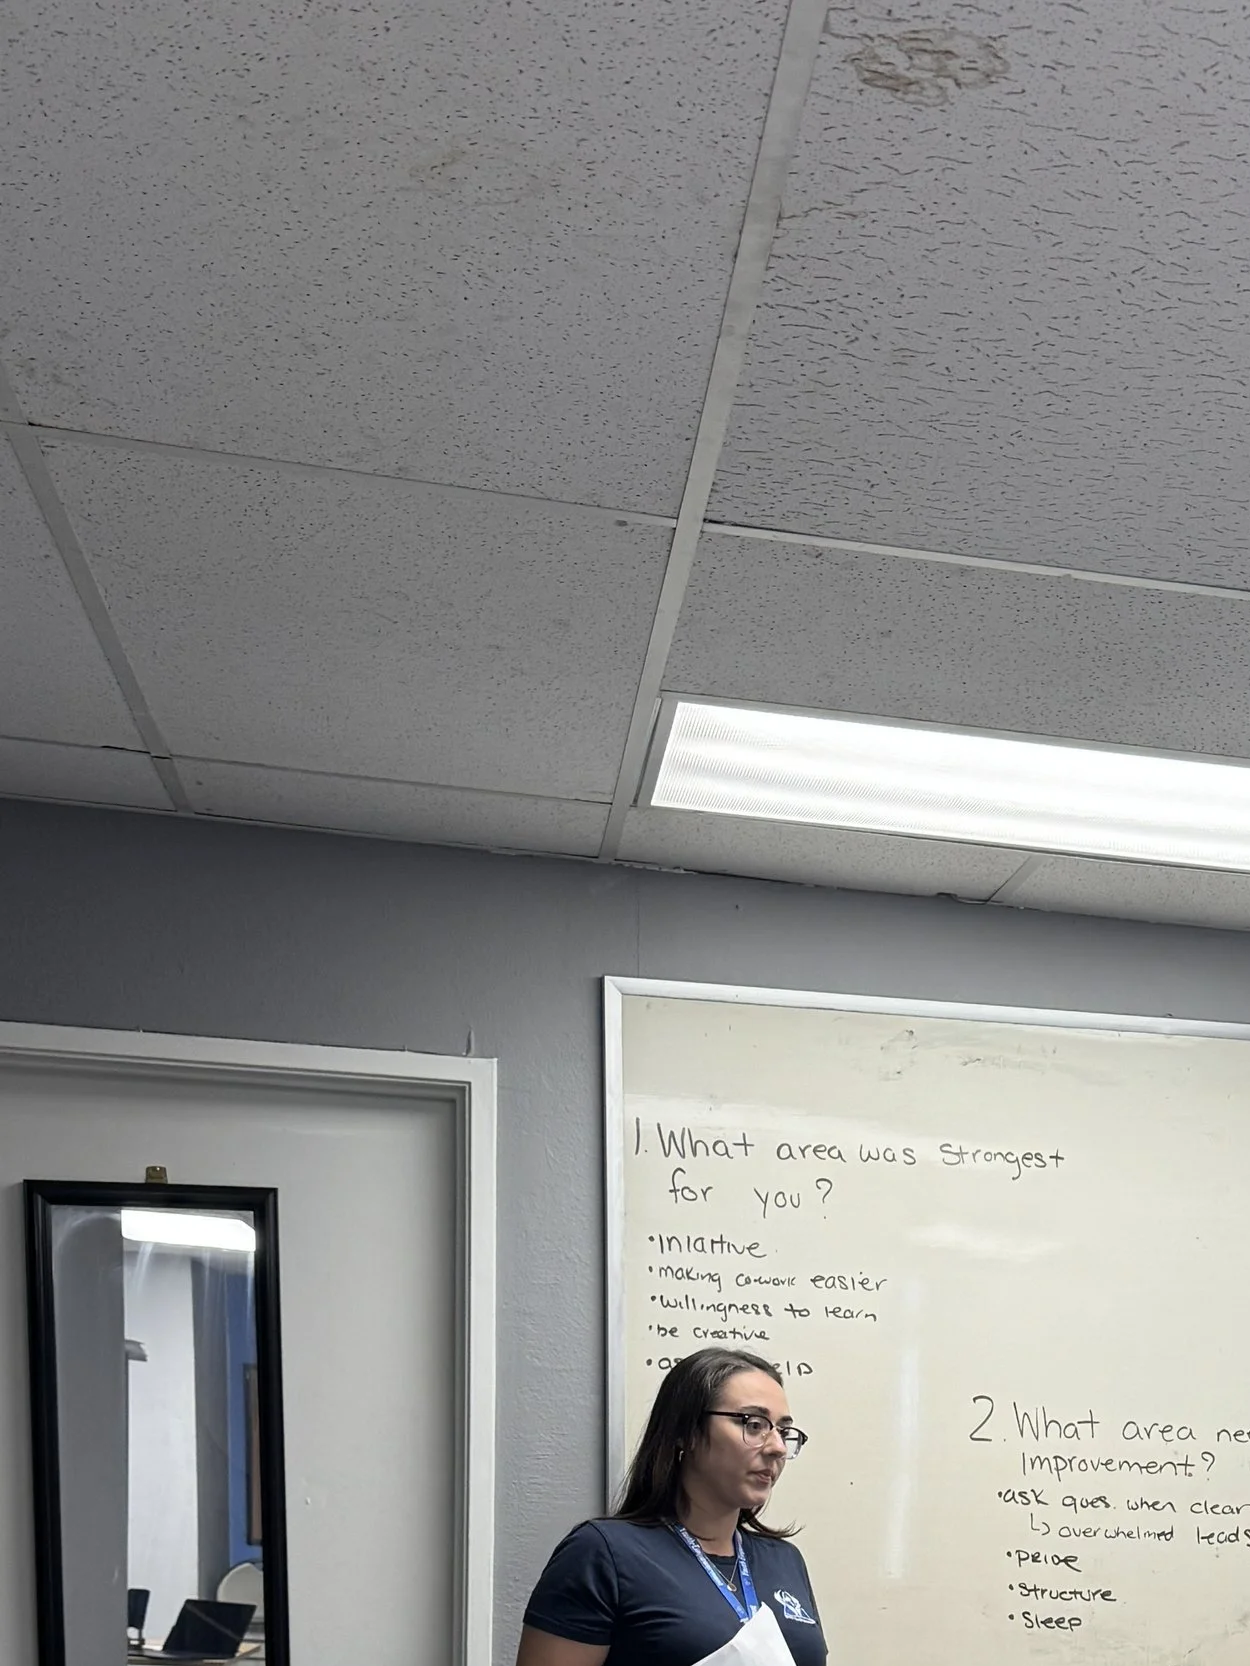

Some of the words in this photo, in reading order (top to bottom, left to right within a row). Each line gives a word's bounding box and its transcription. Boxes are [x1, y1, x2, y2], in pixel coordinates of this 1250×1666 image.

[657, 1123, 754, 1160] What
[777, 1144, 846, 1162] area
[859, 1146, 916, 1165] was
[669, 1168, 713, 1203] for
[659, 1267, 722, 1289] making
[810, 1271, 887, 1292] easier
[784, 1303, 810, 1319] to
[825, 1307, 877, 1322] learn
[657, 1325, 679, 1339] be
[969, 1396, 1006, 1442] 2.
[1014, 1401, 1099, 1441] What
[1122, 1421, 1196, 1442] area
[1003, 1489, 1048, 1505] ask
[1127, 1498, 1176, 1513] when
